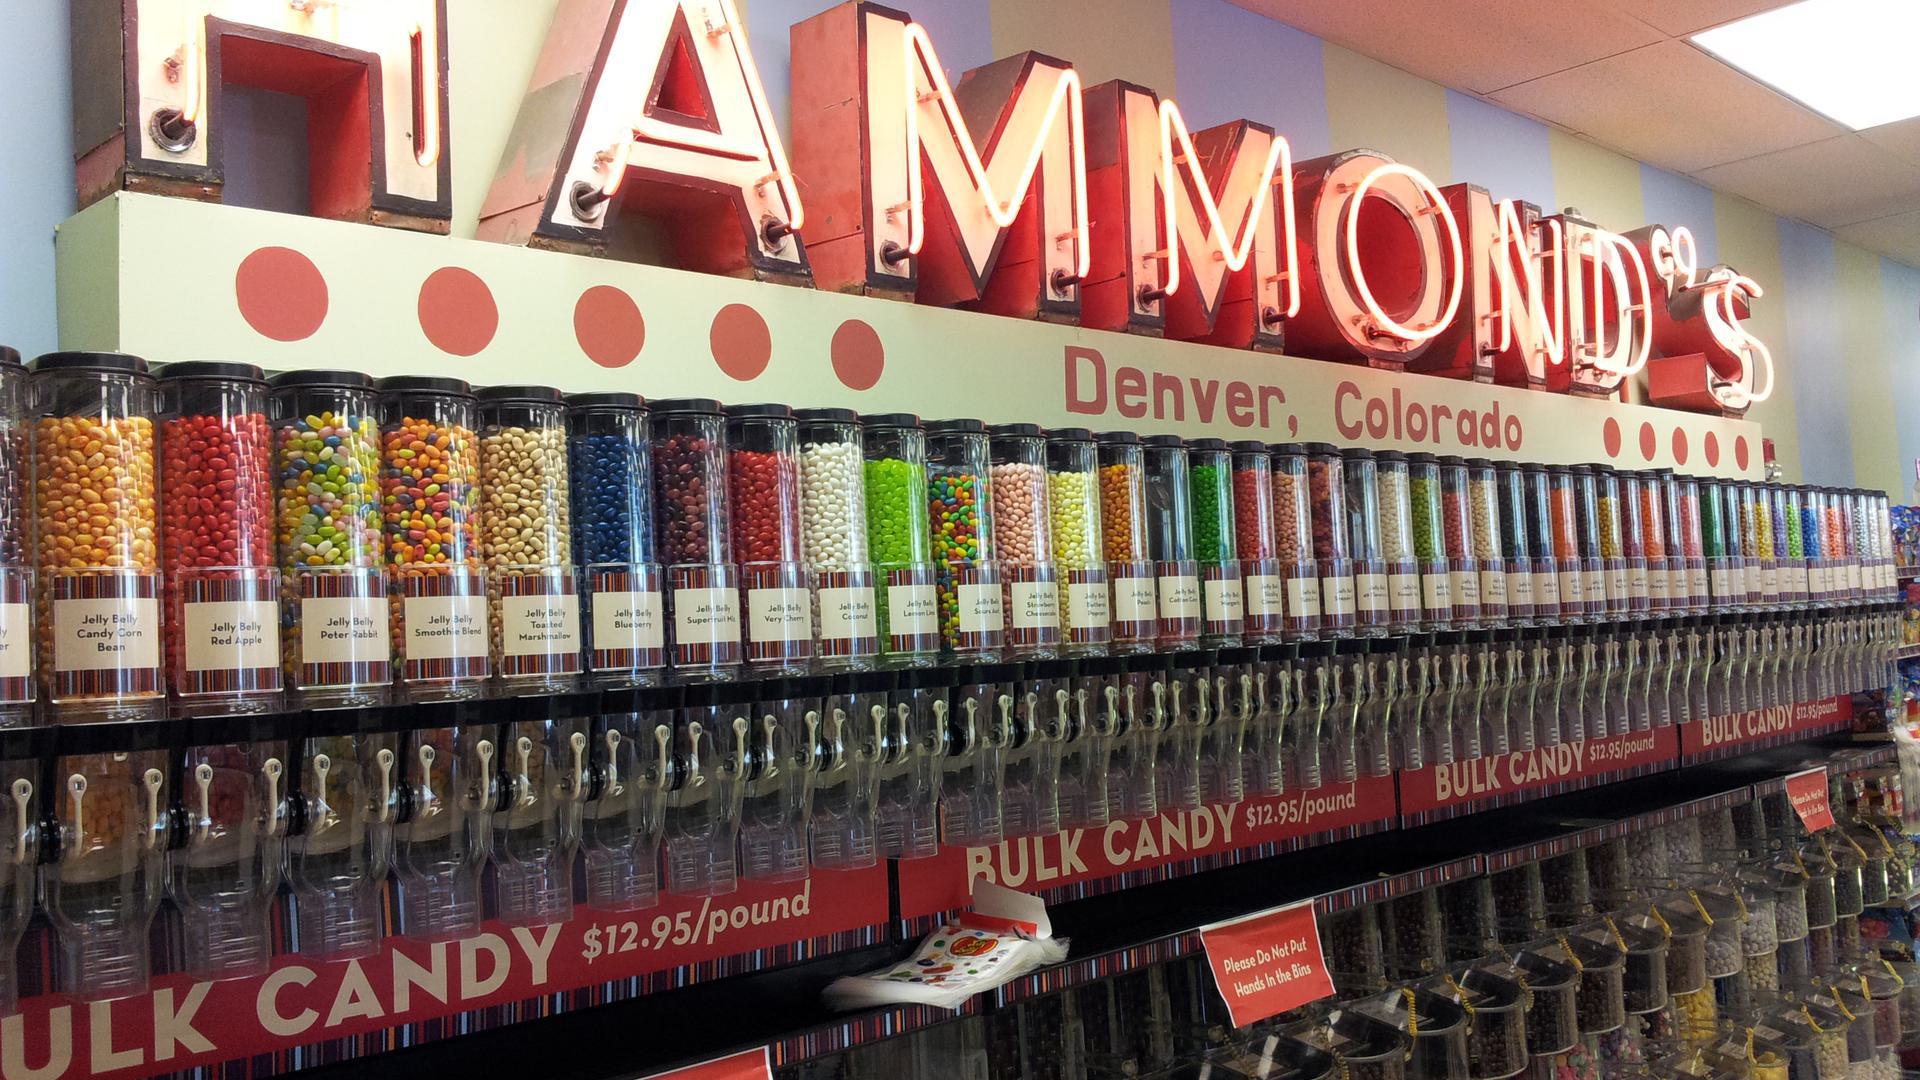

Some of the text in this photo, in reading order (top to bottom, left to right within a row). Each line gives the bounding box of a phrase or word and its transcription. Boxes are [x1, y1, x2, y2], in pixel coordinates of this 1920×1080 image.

[110, 0, 1775, 416] HAMMOND'S
[1065, 345, 1523, 452] Denver, Colorado
[525, 608, 566, 619] Jelly Belly
[614, 609, 633, 619] Jelly
[696, 604, 712, 613] Jelly
[768, 604, 785, 613] Jelly
[82, 614, 138, 626] Jelly Belly
[326, 617, 374, 628] Jelly Belly
[428, 615, 473, 626] Jelly Belly
[764, 615, 782, 624] Very
[211, 622, 261, 633] Jelly Belly
[462, 627, 482, 636] Blend
[77, 628, 142, 639] Candy Corn
[320, 630, 378, 640] Peter Rabbit
[211, 636, 262, 646] Red Apple
[97, 642, 126, 652] Bean
[1702, 695, 1838, 746] BULK CANDY $12.95/pound
[1435, 731, 1655, 801] BULK CANDY $12.95/pound
[966, 782, 1357, 896] BULK CANDY $12.95/pound
[1223, 936, 1307, 975] Please Do Not Put
[0, 879, 811, 1080] ULK CANDY $12.95/pound
[1233, 963, 1312, 998] Hands In the Bins
